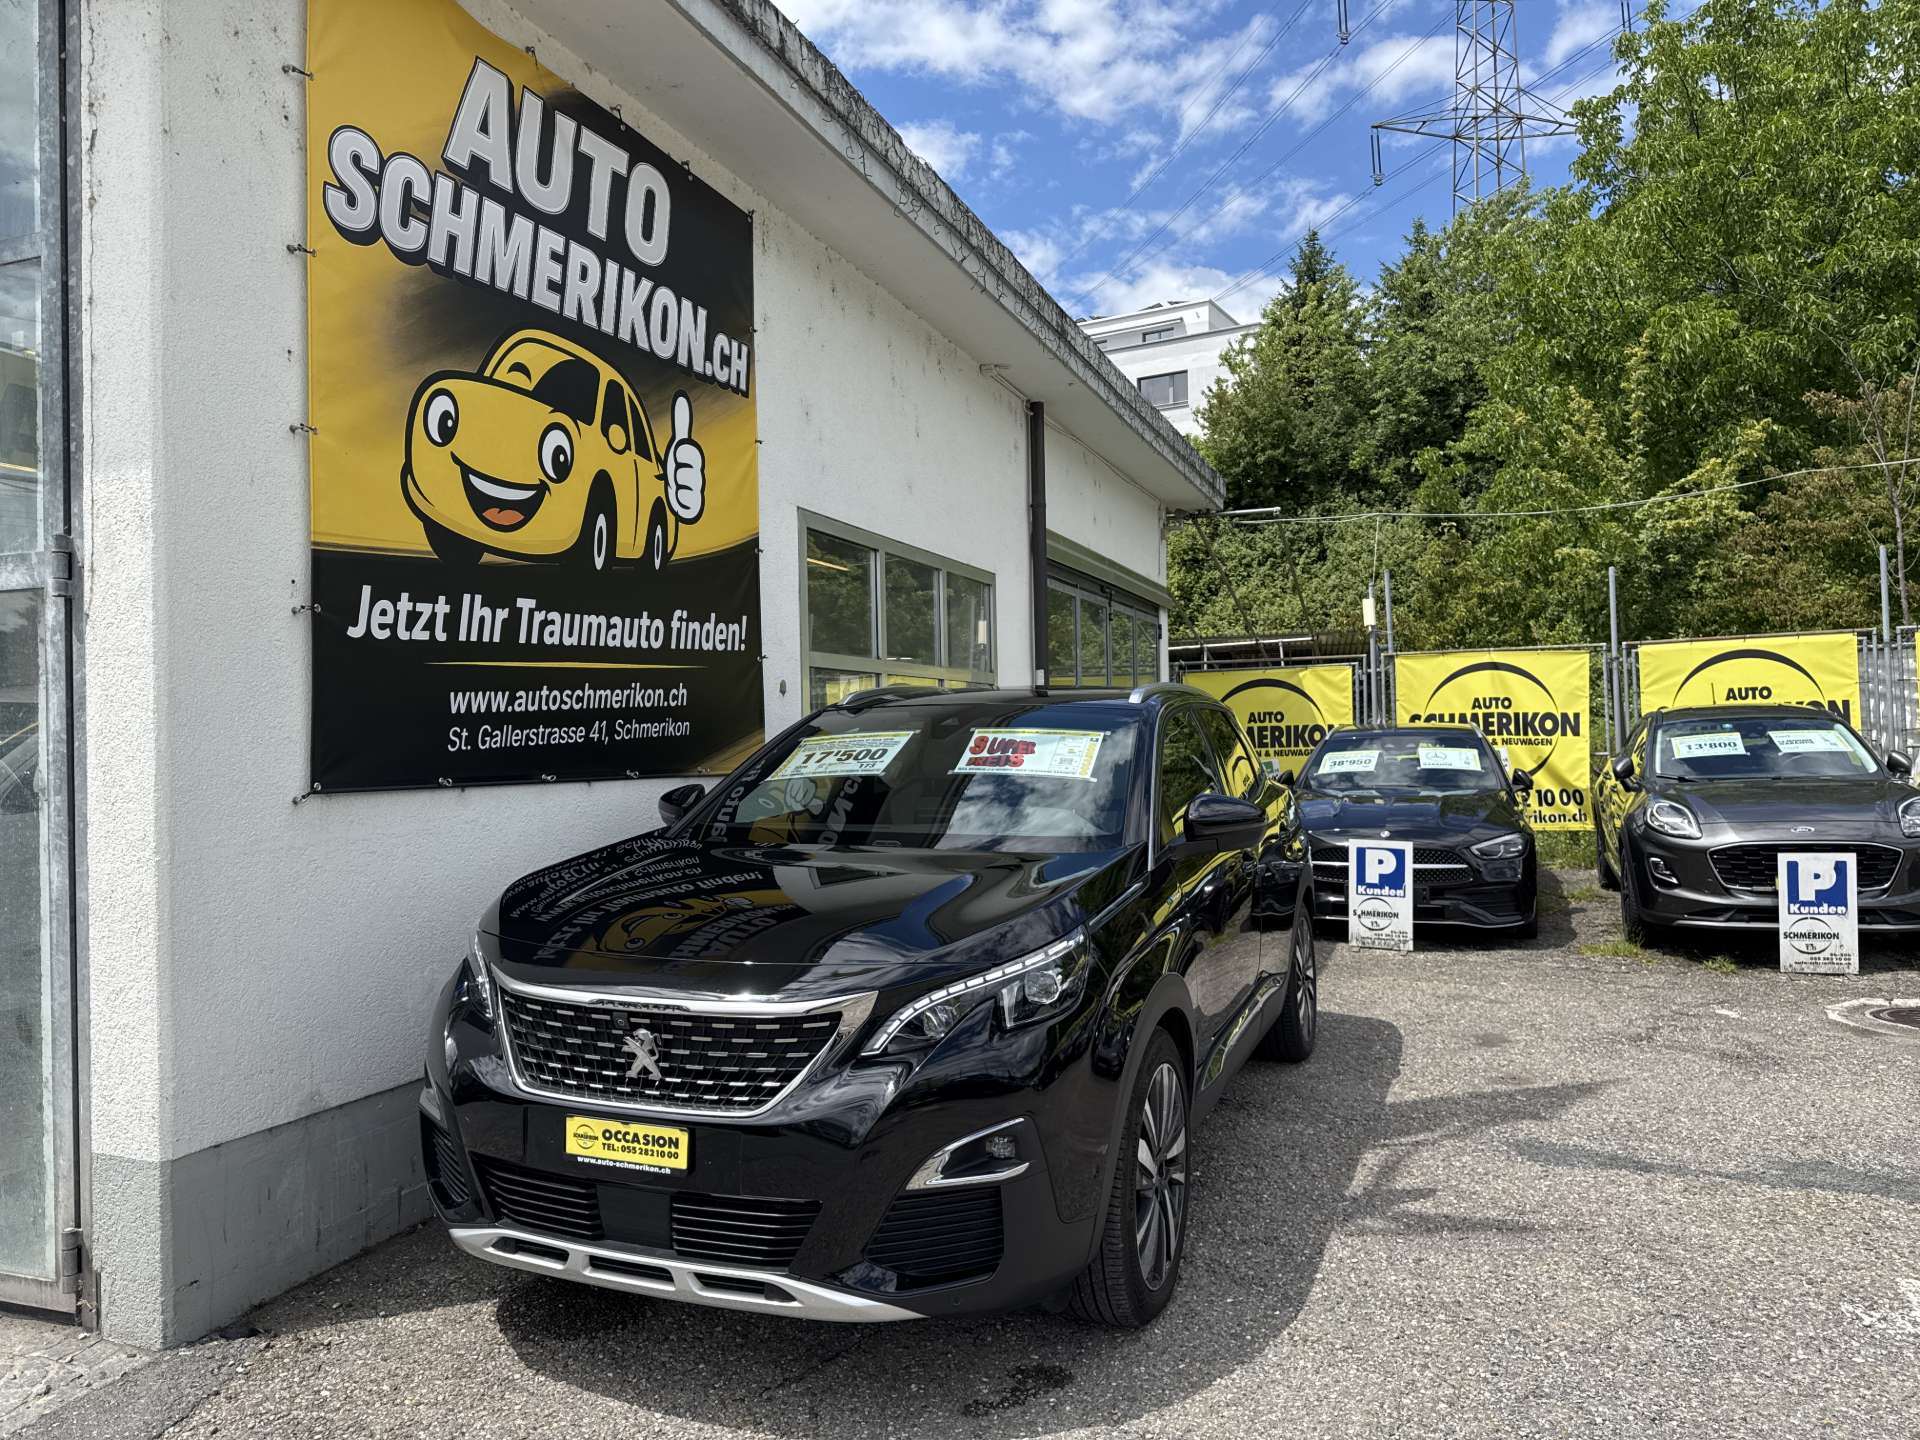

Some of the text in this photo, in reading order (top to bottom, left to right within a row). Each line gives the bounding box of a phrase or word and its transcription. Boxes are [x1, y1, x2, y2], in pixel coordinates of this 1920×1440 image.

[442, 57, 671, 267] AUTO
[323, 127, 750, 395] SCHMERIKON.CH
[346, 585, 747, 651] Jetzt Ihr Traumauto finden!
[449, 682, 688, 714] www.autoschmerikon.ch
[1725, 686, 1772, 700] AUTO
[1471, 697, 1512, 710] AUTO
[1248, 711, 1284, 724] AUTO
[447, 717, 690, 752] St. Gallerstrasse 41, Schmerikon
[1490, 737, 1553, 746] & NEUWAGEN
[802, 748, 888, 765] 17'500
[1535, 788, 1555, 808] 10
[1559, 788, 1584, 807] 00
[1365, 848, 1397, 884] P
[1357, 884, 1405, 897] Kunden
[1353, 909, 1399, 919] SHMERIKON
[1789, 903, 1847, 915] Kunden
[1783, 931, 1839, 940] SCHMERIKON
[602, 1128, 680, 1150] OCCASION
[602, 1142, 619, 1152] TEL:
[621, 1144, 636, 1154] 055
[667, 1150, 679, 1160] 00
